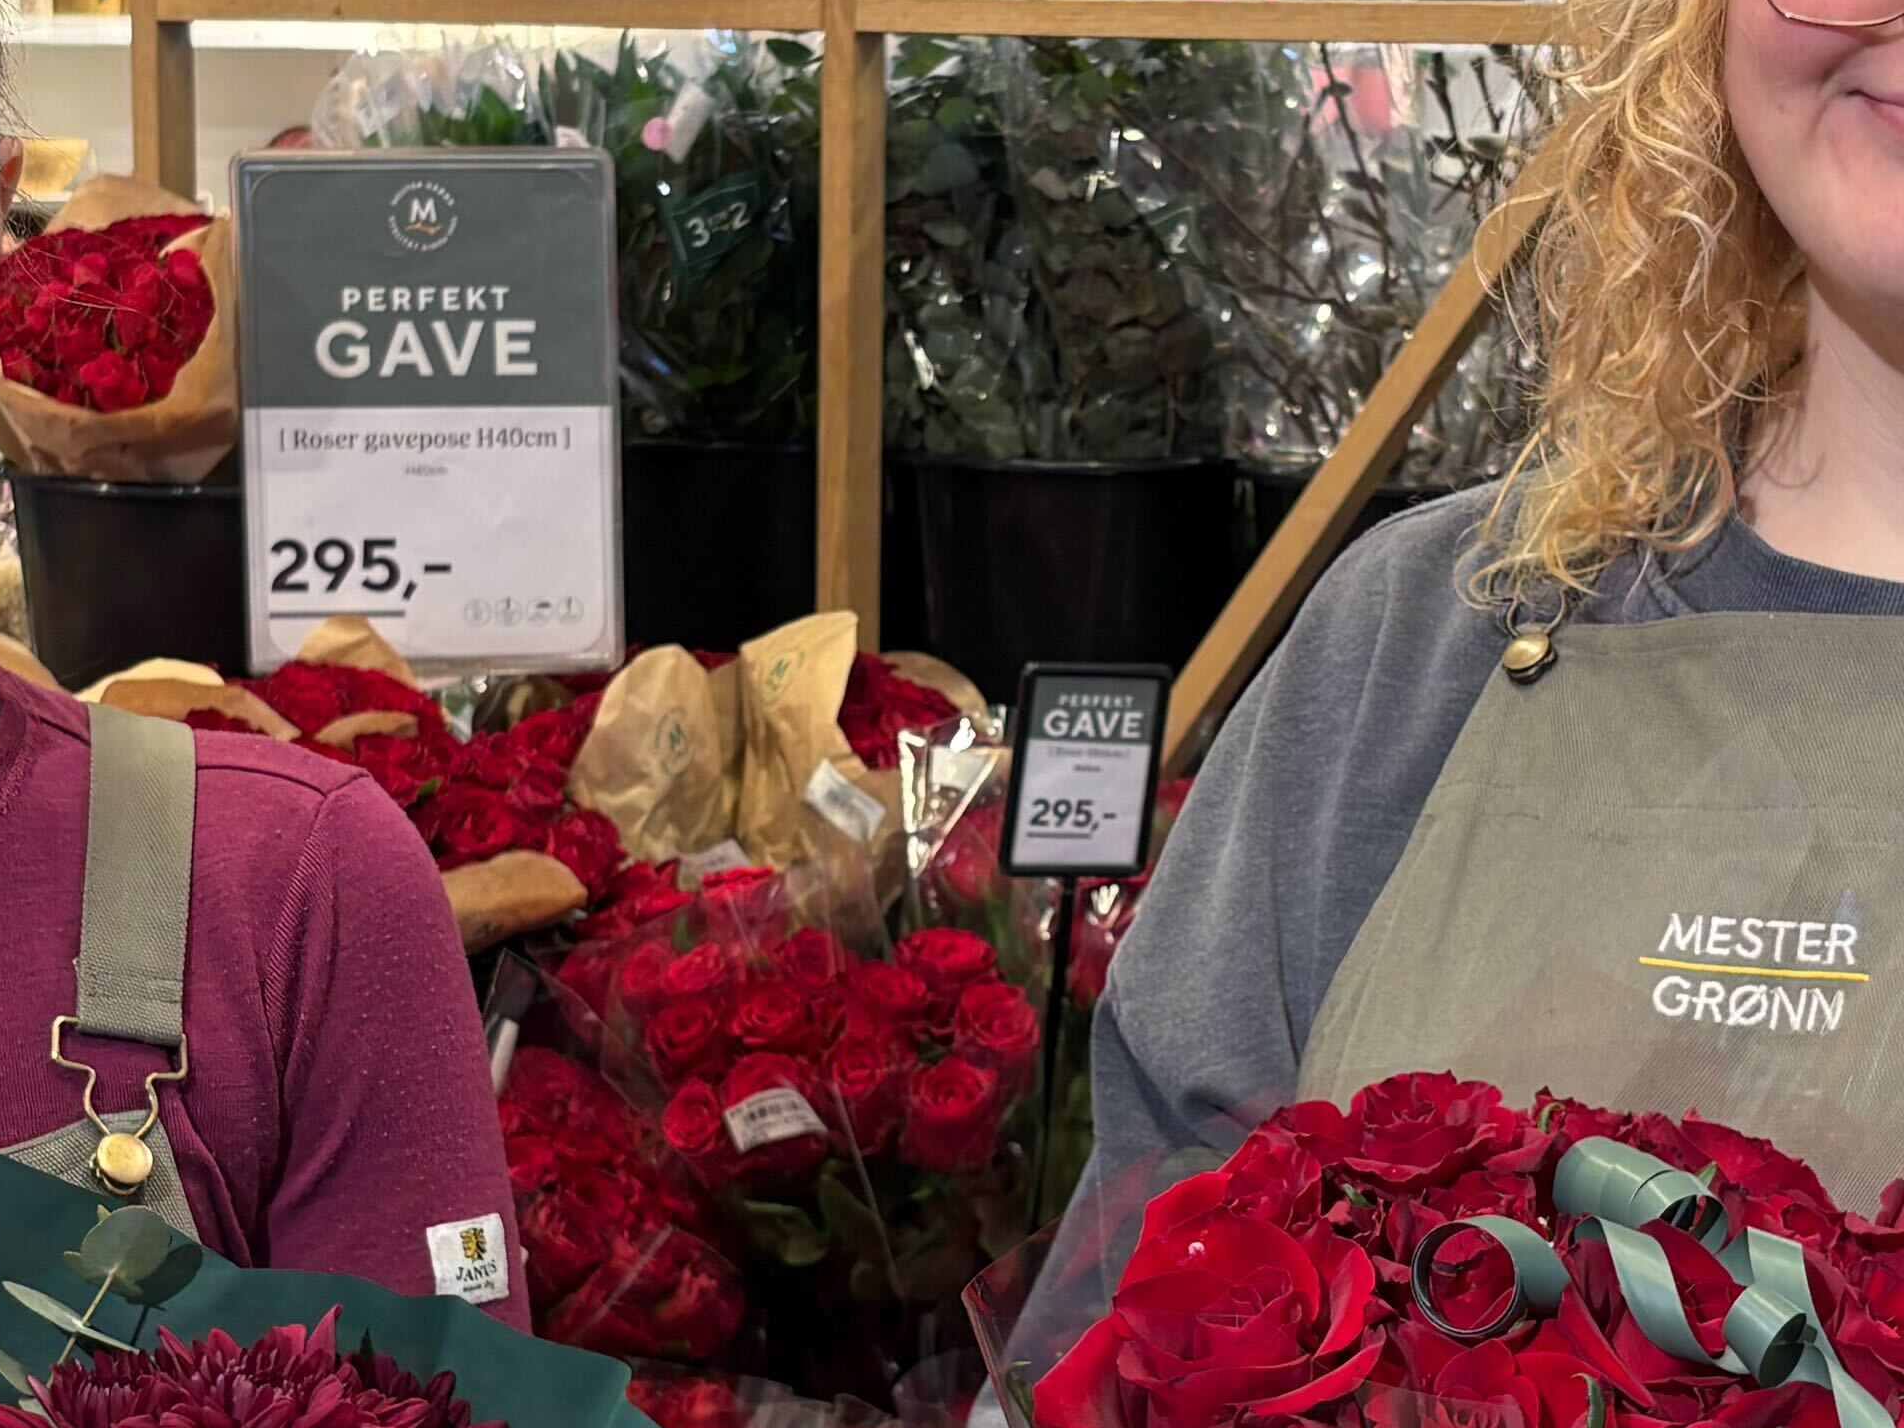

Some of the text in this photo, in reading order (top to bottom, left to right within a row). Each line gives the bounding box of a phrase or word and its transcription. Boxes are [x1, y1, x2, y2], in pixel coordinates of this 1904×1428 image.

[409, 197, 437, 223] M
[686, 216, 710, 249] 3
[729, 201, 752, 231] 2
[341, 285, 510, 312] PERFEKT
[314, 320, 538, 378] GAVE
[294, 428, 356, 450] Roser
[364, 429, 472, 453] gavepose
[477, 427, 558, 449] H40cm
[269, 539, 453, 601] 295,-
[1058, 693, 1134, 708] PERFEKT
[1043, 709, 1143, 739] GAVE
[1029, 798, 1116, 832] 295,-
[1658, 913, 1858, 965] MESTER
[1653, 975, 1845, 1035] GRØNN
